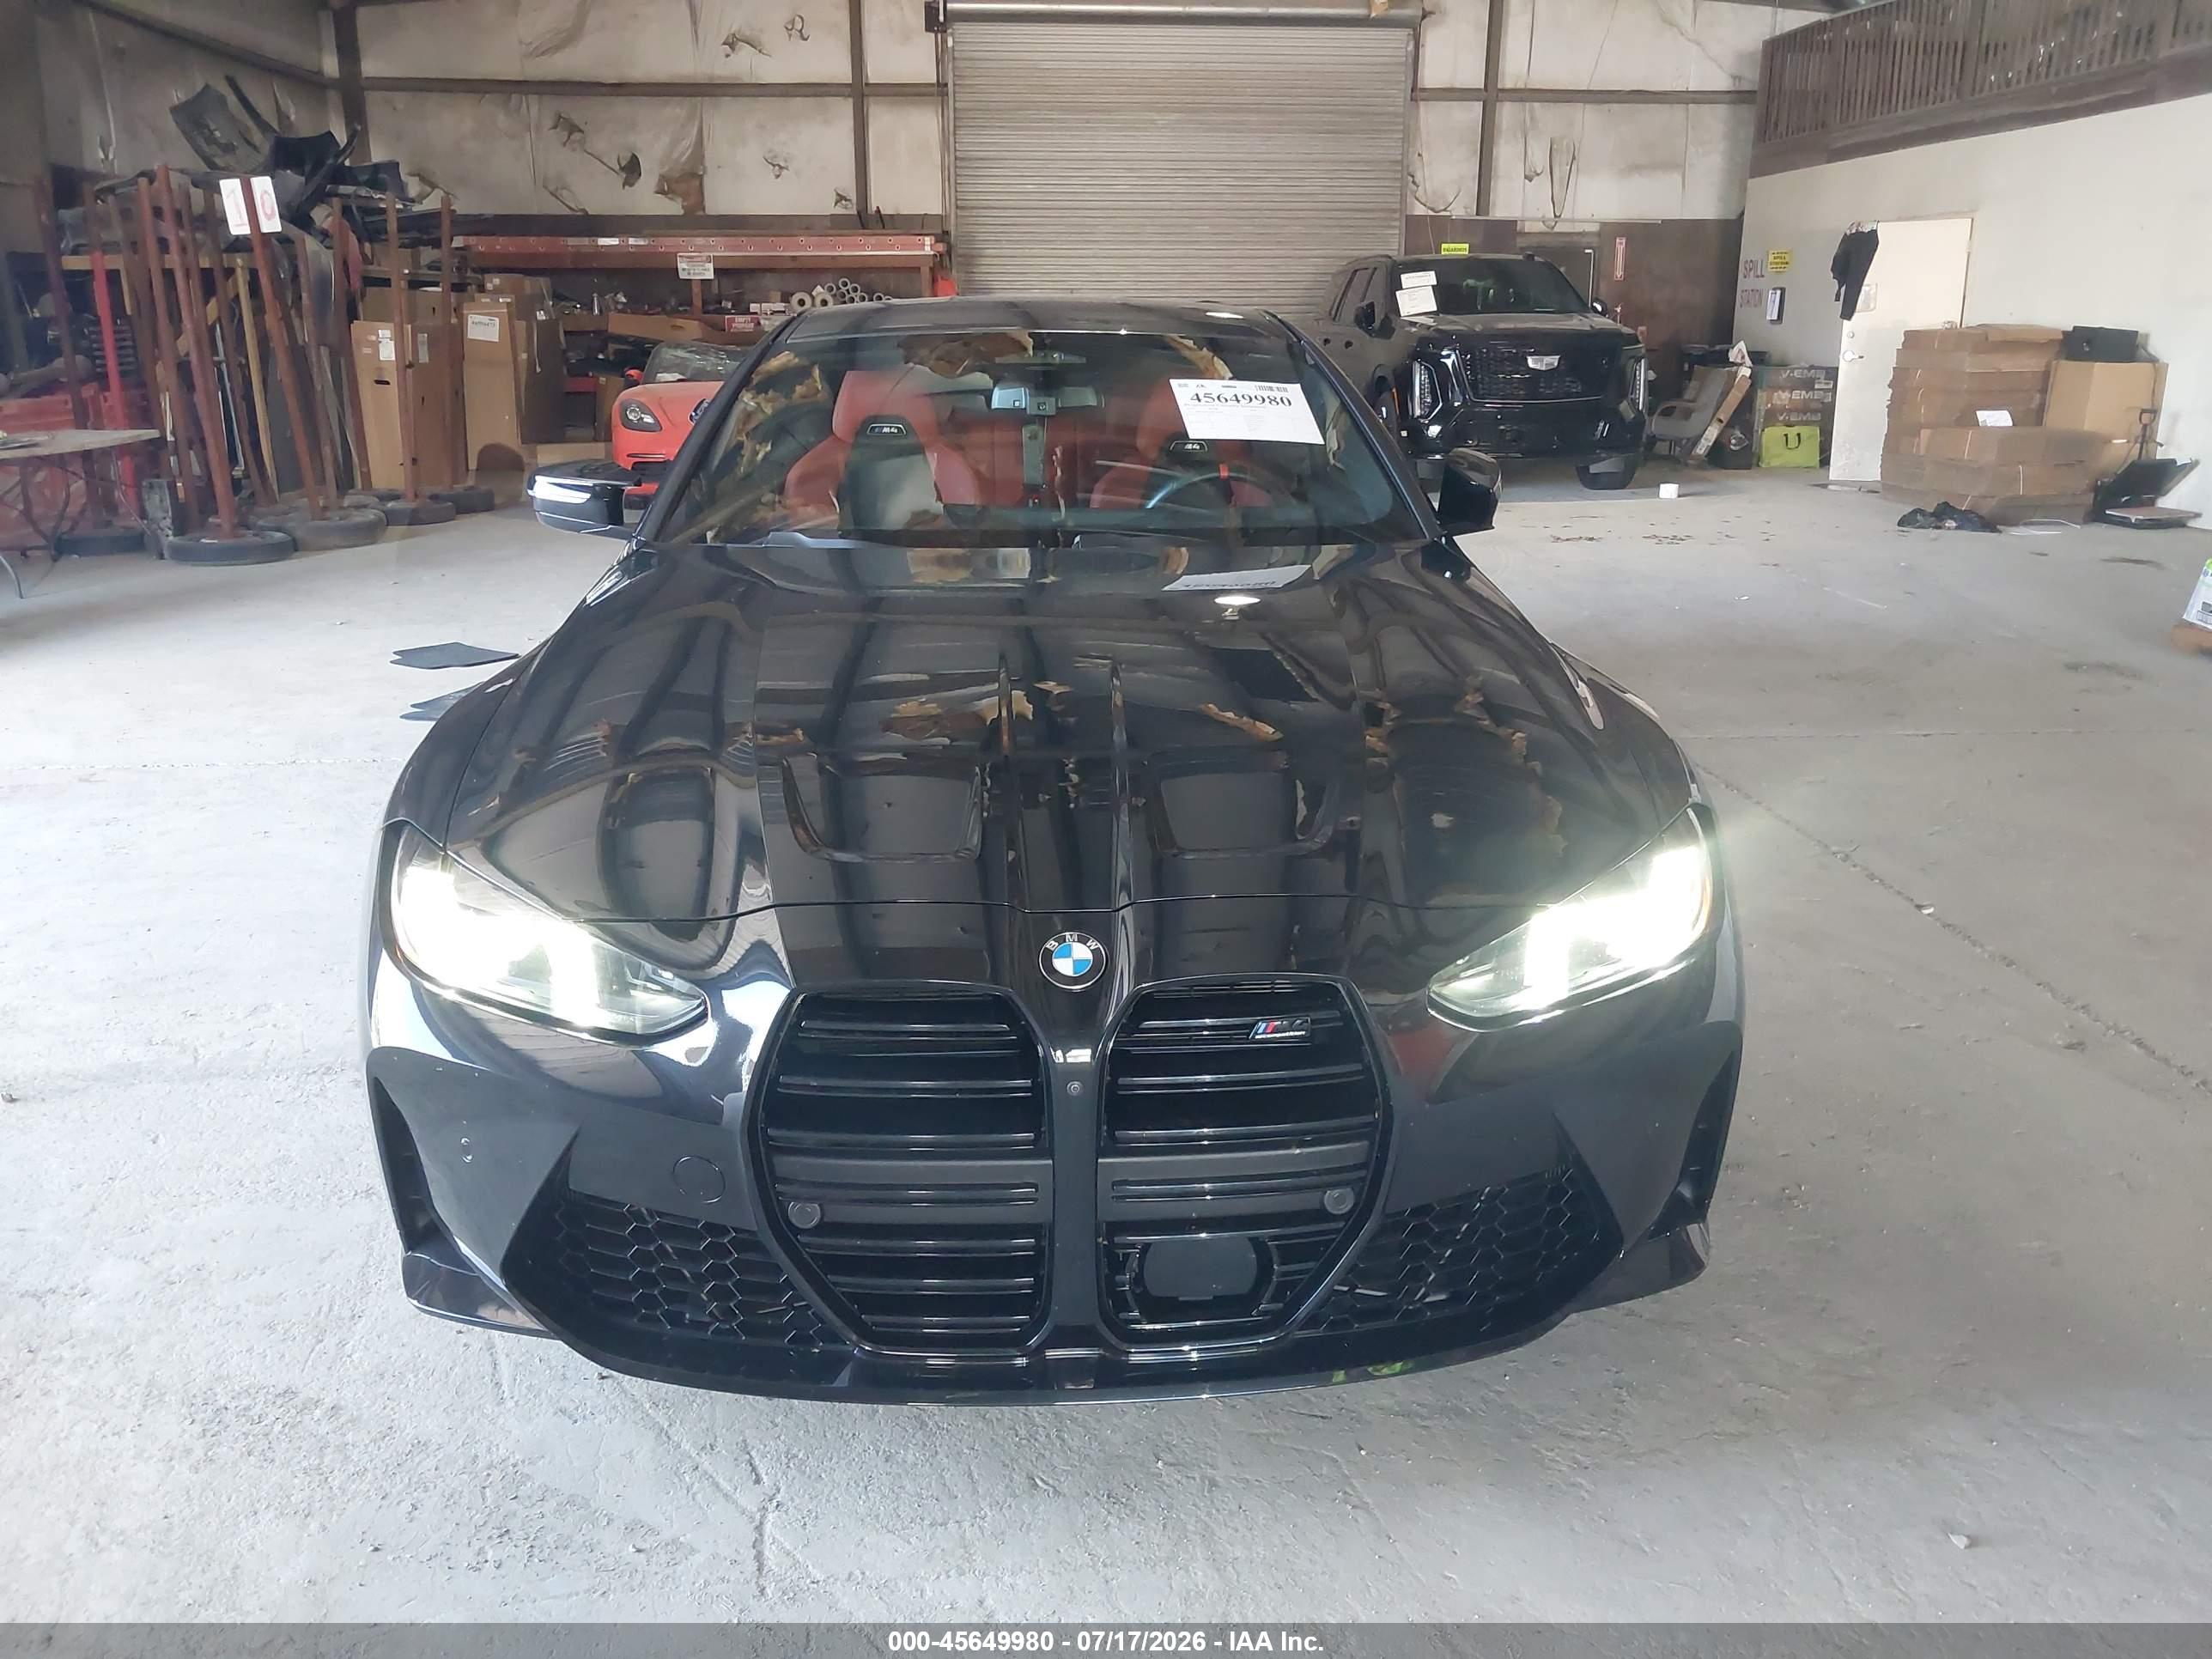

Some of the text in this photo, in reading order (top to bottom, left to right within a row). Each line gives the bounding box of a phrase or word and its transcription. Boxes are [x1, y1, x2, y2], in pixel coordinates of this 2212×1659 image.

[1743, 259, 1765, 278] SPILL
[1740, 289, 1764, 308] STATION
[1190, 392, 1292, 407] 45649980
[1046, 933, 1099, 951] BMW
